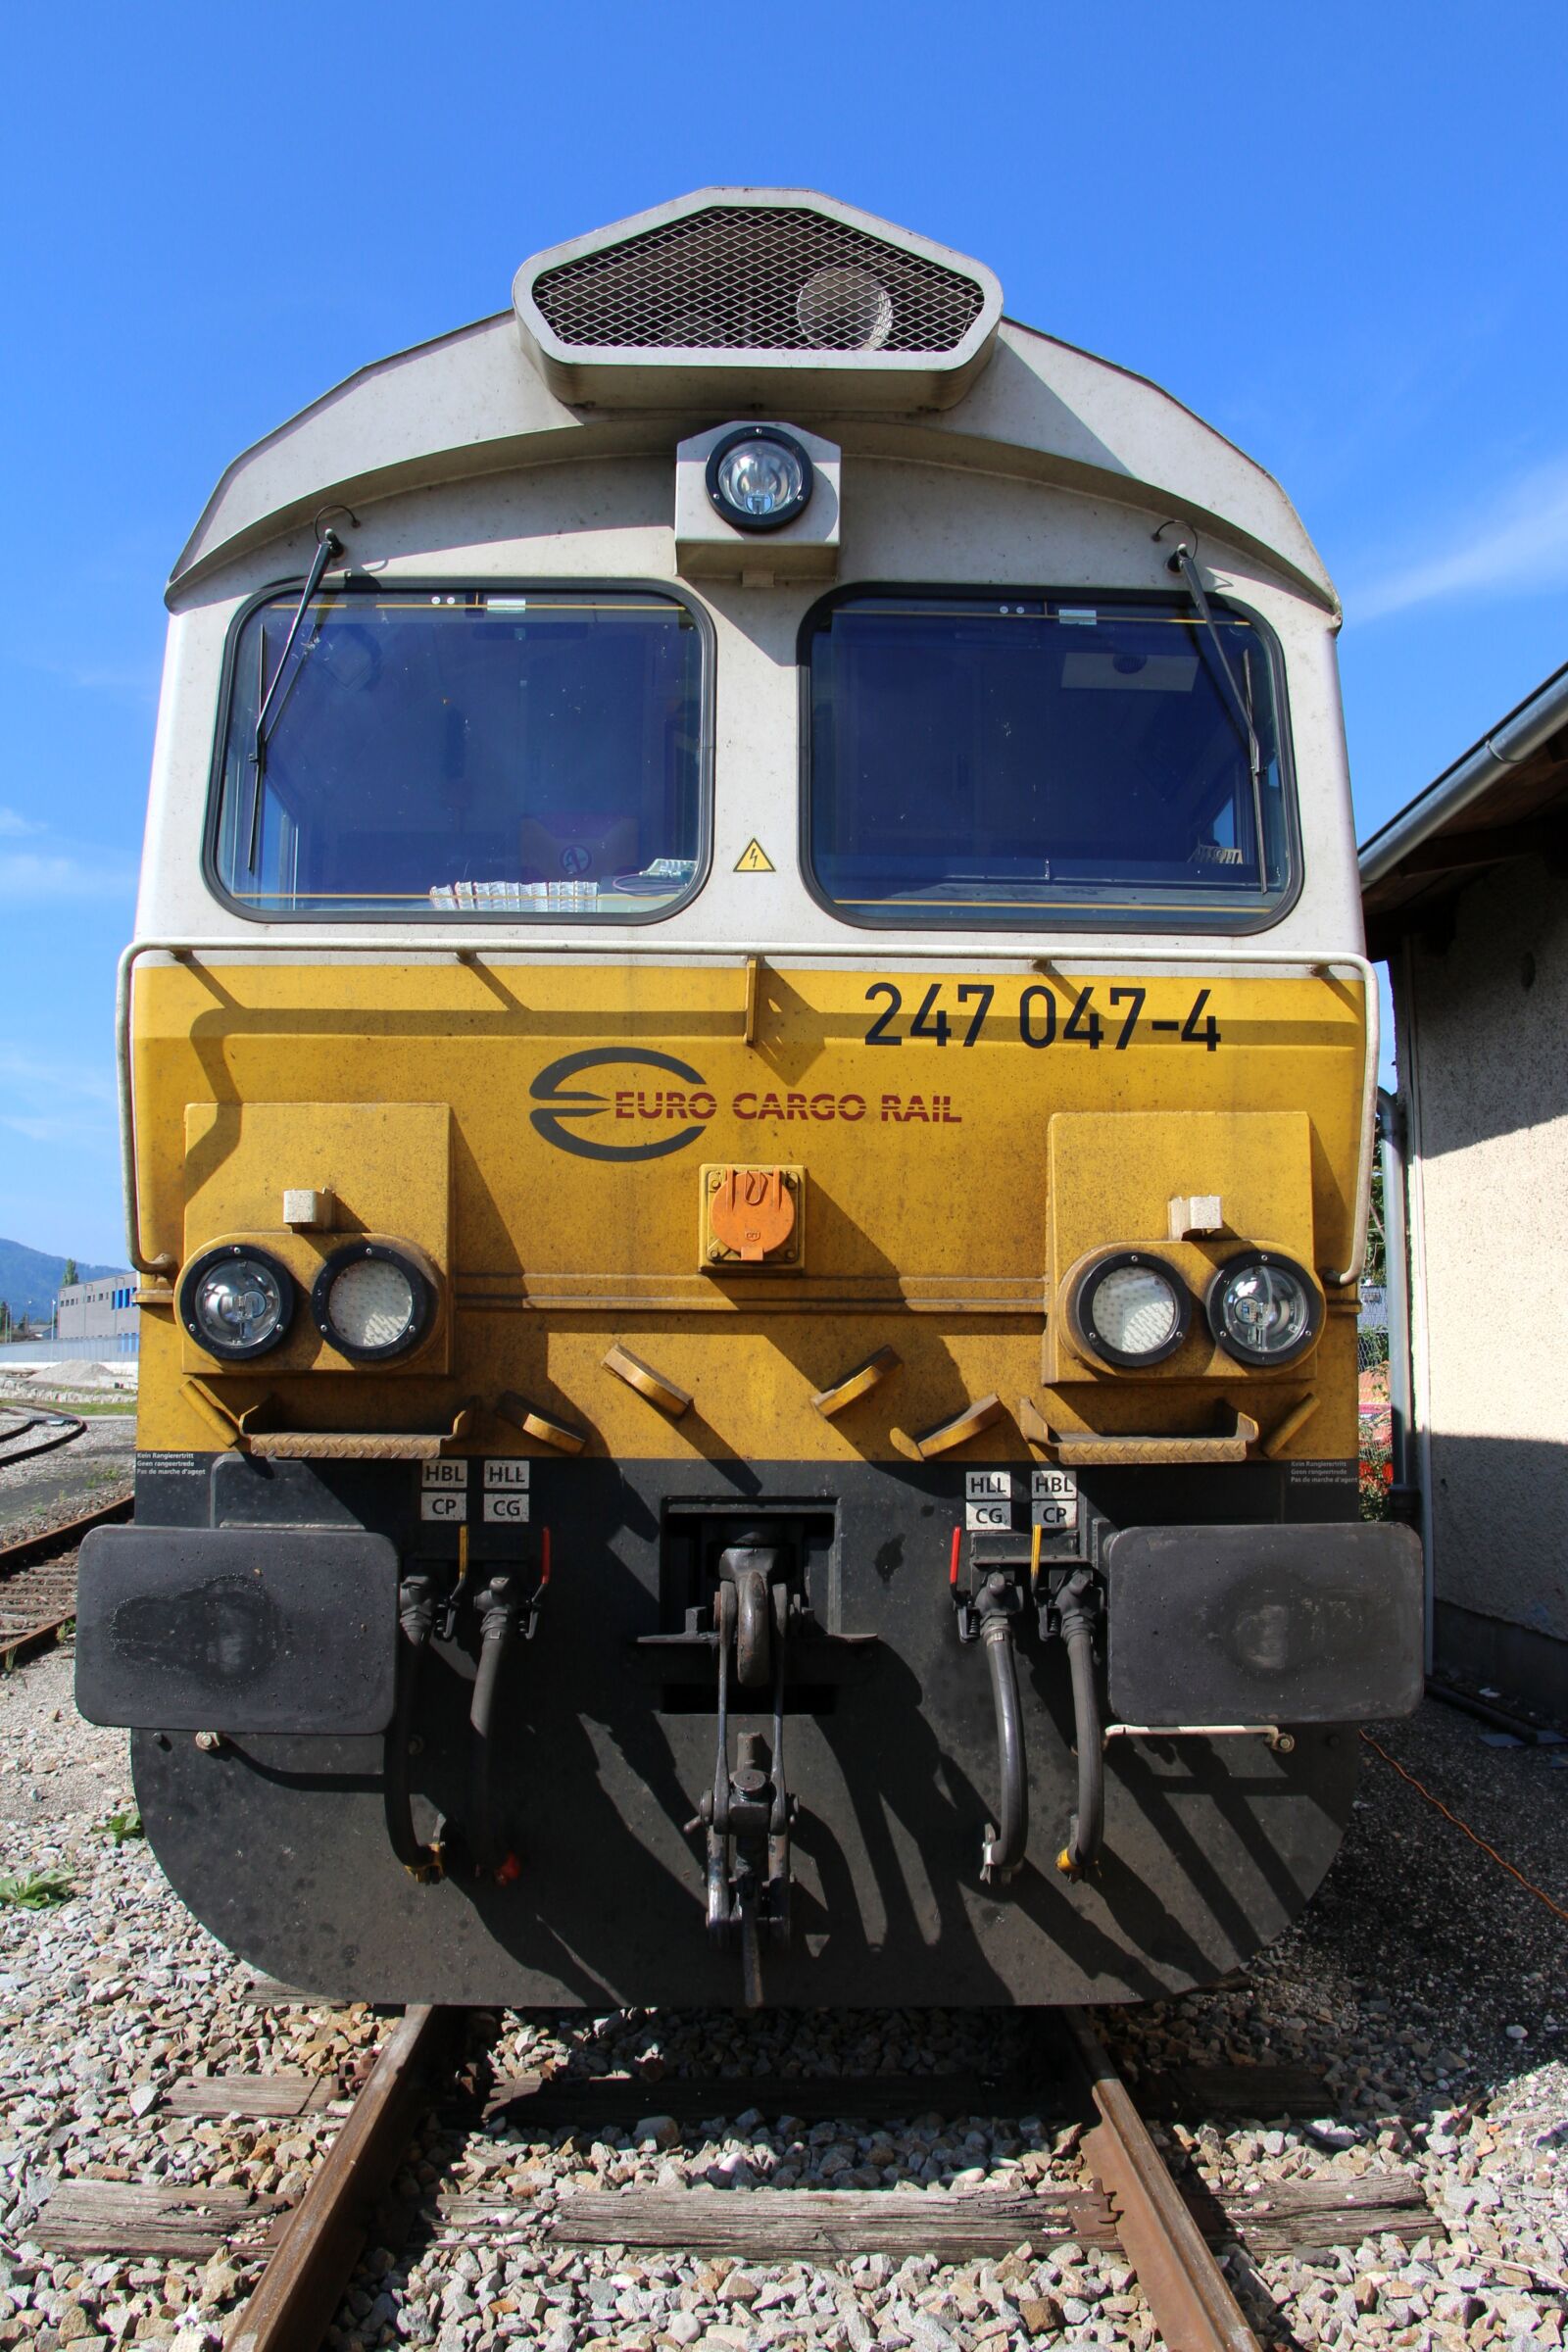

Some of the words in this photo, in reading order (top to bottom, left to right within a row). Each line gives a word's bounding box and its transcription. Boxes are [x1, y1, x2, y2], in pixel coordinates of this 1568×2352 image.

[864, 981, 995, 1047] 247
[1019, 984, 1222, 1053] 047-4
[614, 1091, 717, 1120] EURO
[732, 1093, 867, 1122] CARGO
[881, 1095, 962, 1123] RAIL
[425, 1465, 465, 1482] HBL
[489, 1466, 525, 1483] HLL
[970, 1477, 1006, 1494] HLL
[1035, 1477, 1073, 1493] HBL
[431, 1498, 457, 1515] CP
[493, 1499, 520, 1517] CG
[1043, 1507, 1067, 1523] CP
[975, 1507, 1003, 1524] CG
